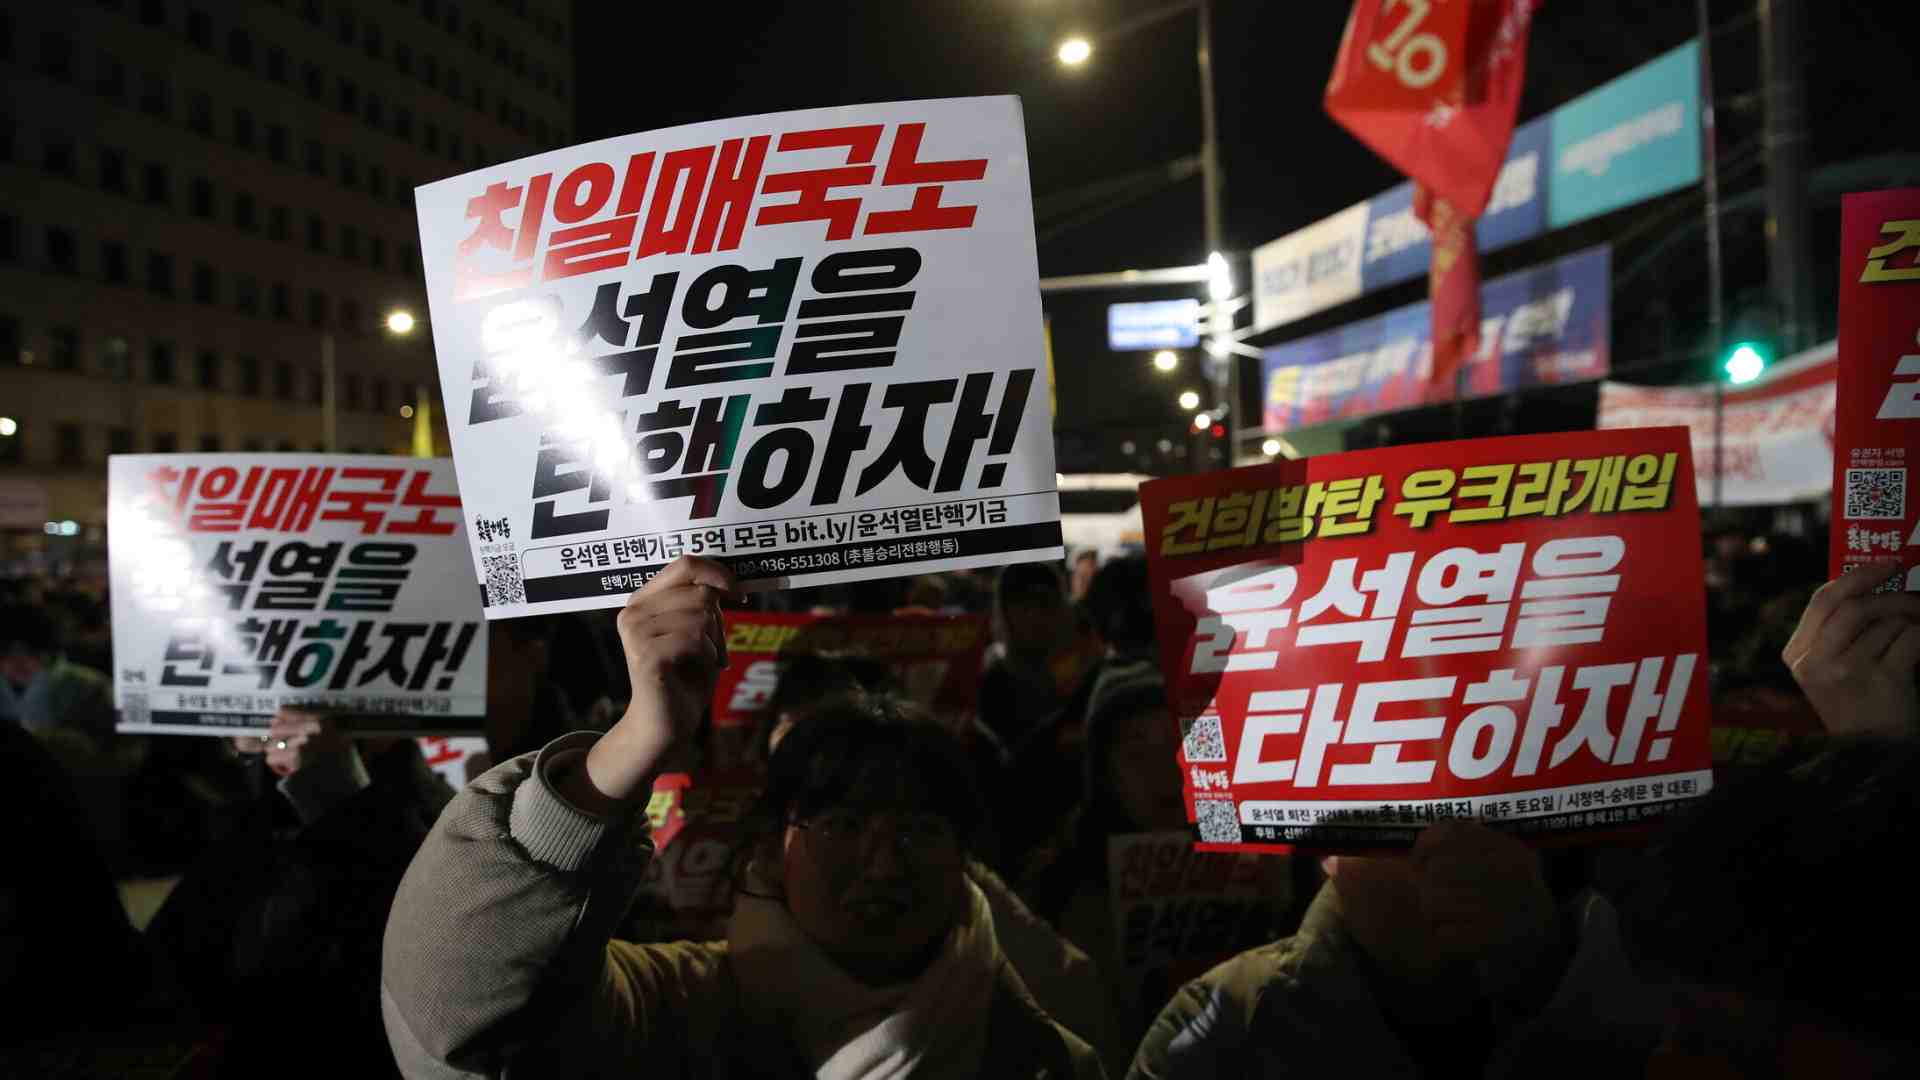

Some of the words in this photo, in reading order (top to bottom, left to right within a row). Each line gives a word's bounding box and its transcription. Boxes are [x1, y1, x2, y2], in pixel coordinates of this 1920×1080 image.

[455, 122, 988, 304] 친일매국노
[531, 368, 1036, 539] 탄핵하자!
[1161, 475, 1384, 557] 건희방탄
[1392, 452, 1678, 530] 우크라개입
[561, 538, 611, 570] 윤석열
[613, 533, 683, 564] 탄핵기금
[691, 528, 727, 553] 5억
[735, 525, 779, 549] 모금
[785, 499, 1008, 544] bit.ly/윤석열탄핵기금
[601, 573, 643, 591] 탄핵기금
[160, 617, 481, 692] 탄핵하자!
[1190, 534, 1626, 675] 윤석열을
[1232, 653, 1699, 788] 타도하자!
